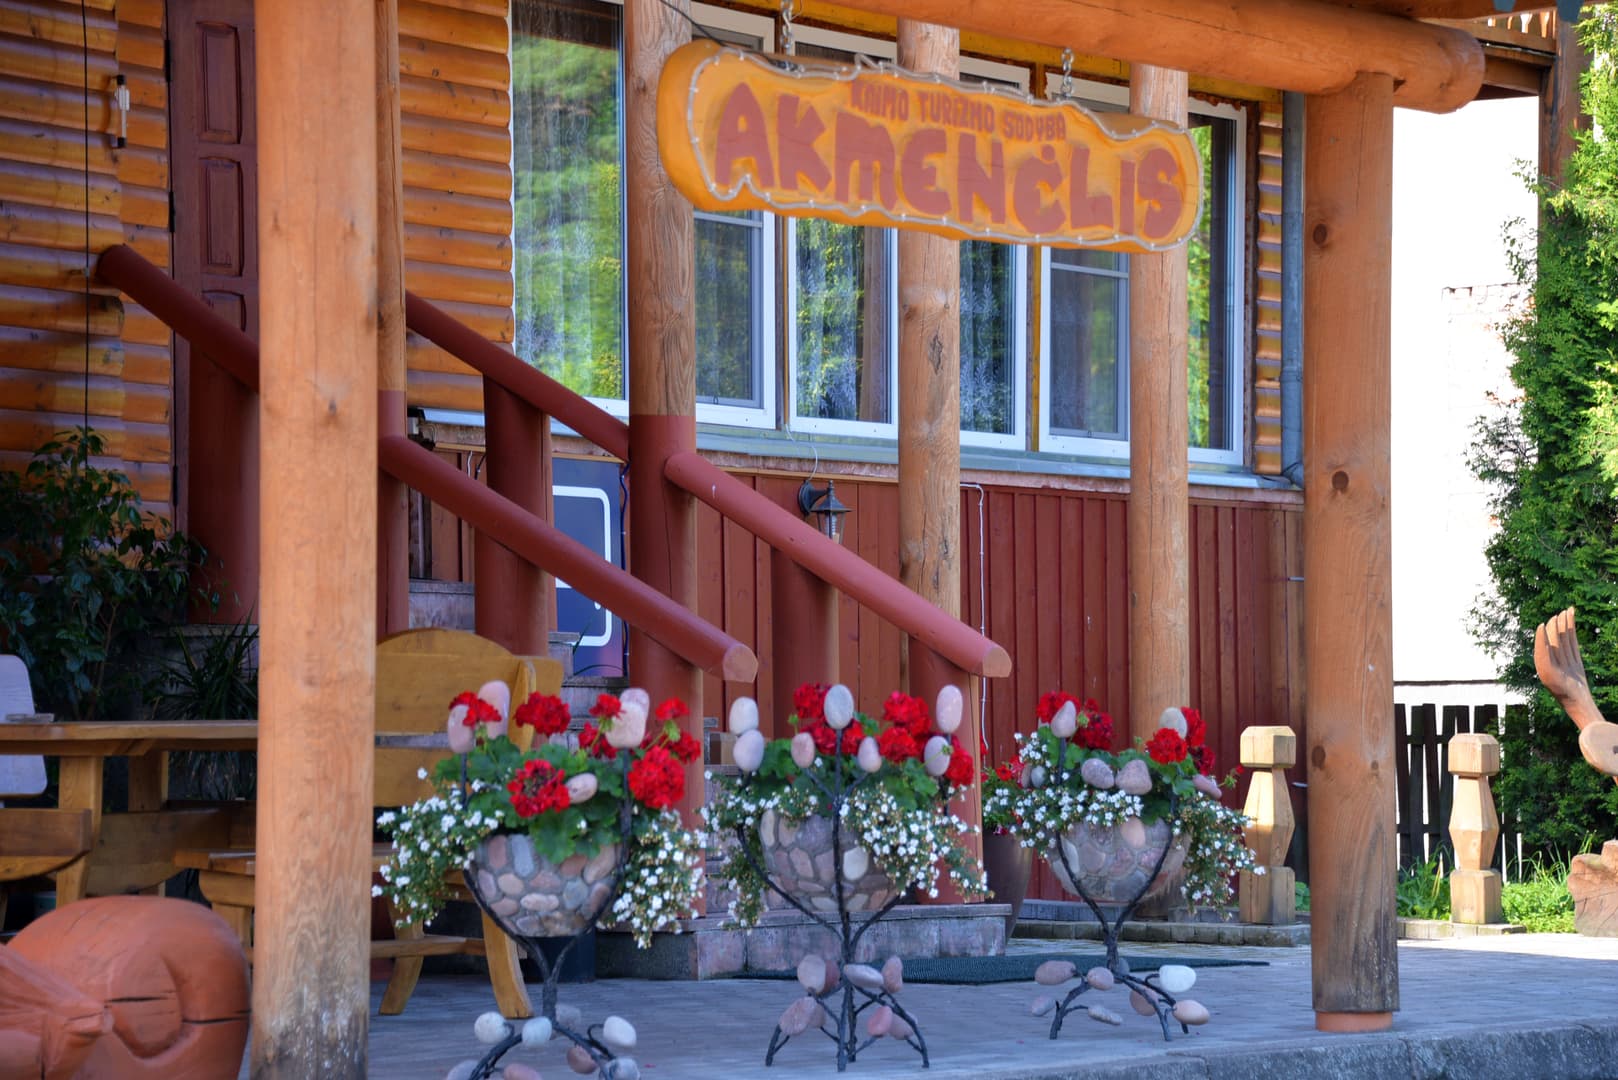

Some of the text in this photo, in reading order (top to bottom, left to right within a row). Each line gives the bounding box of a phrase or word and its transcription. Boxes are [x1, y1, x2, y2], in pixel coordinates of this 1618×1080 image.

[851, 81, 1066, 142] KAIMO TURIZMO SODYBA
